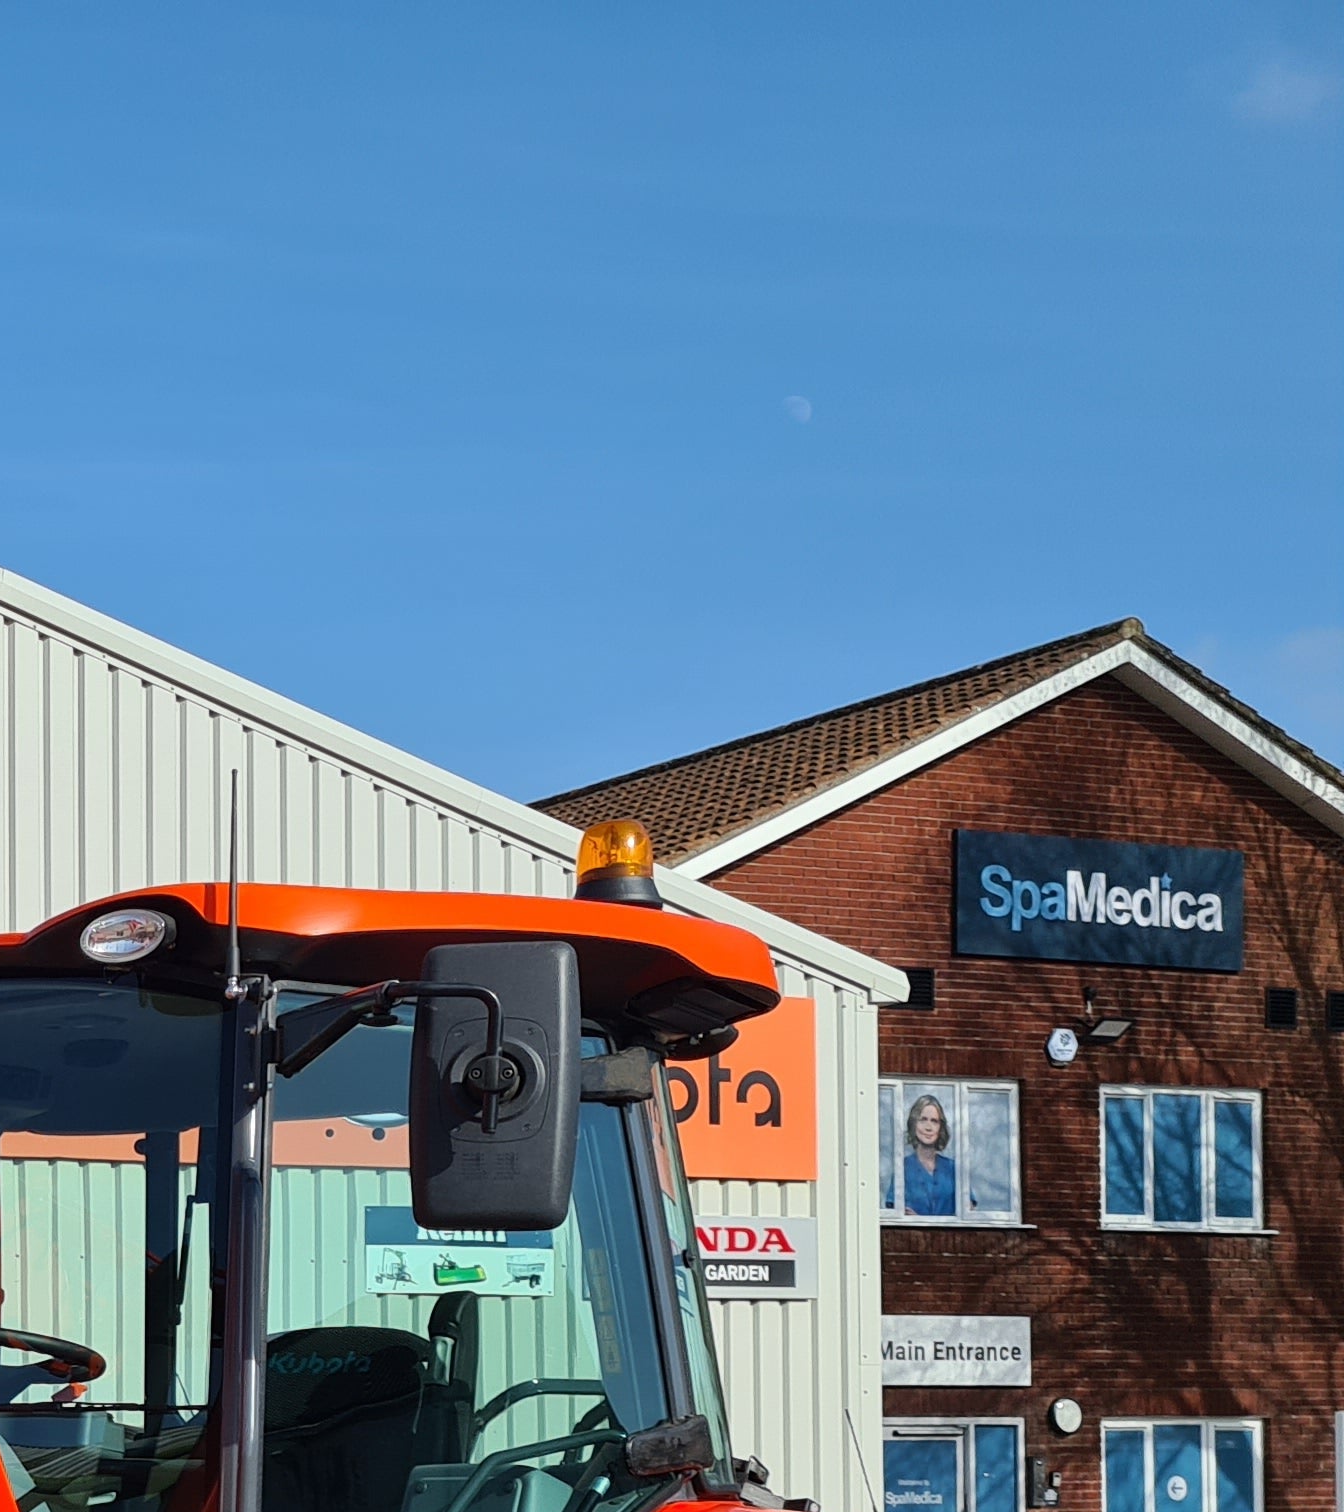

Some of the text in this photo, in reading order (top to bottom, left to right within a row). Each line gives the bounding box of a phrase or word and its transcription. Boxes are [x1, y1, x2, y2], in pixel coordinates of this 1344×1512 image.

[980, 865, 1224, 932] SpaMedica
[666, 1054, 781, 1128] ota
[695, 1226, 796, 1253] NDA
[705, 1264, 770, 1283] GARDEN
[881, 1340, 1022, 1362] Main Entrance
